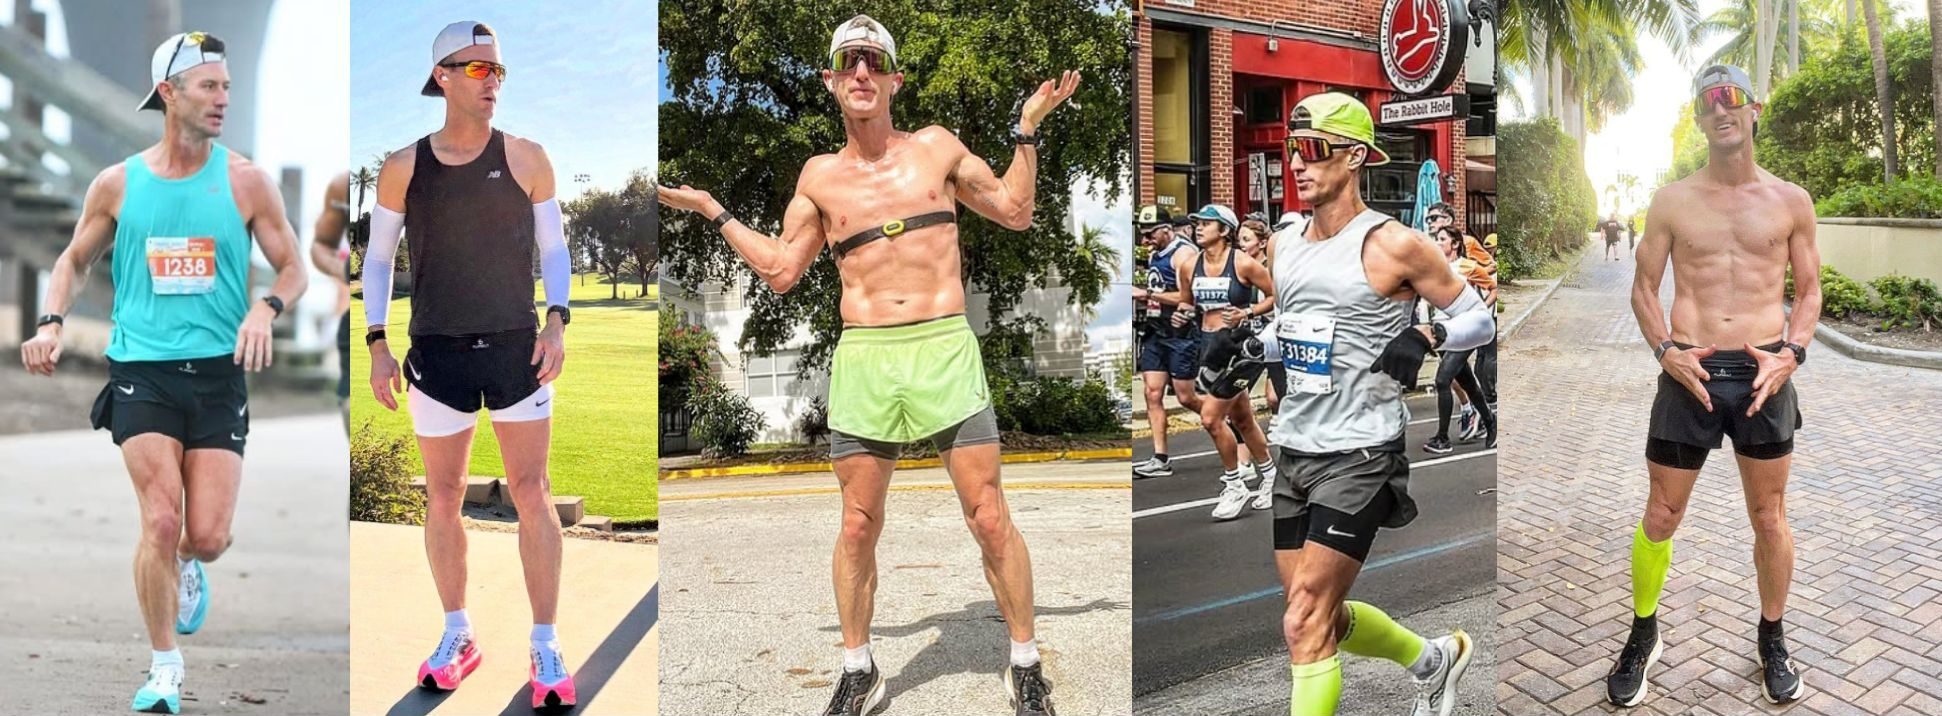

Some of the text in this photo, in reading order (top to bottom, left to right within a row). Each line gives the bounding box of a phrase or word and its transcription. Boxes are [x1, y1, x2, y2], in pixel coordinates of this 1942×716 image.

[1383, 100, 1451, 119] The Rabbit Hole
[164, 257, 207, 275] 1238
